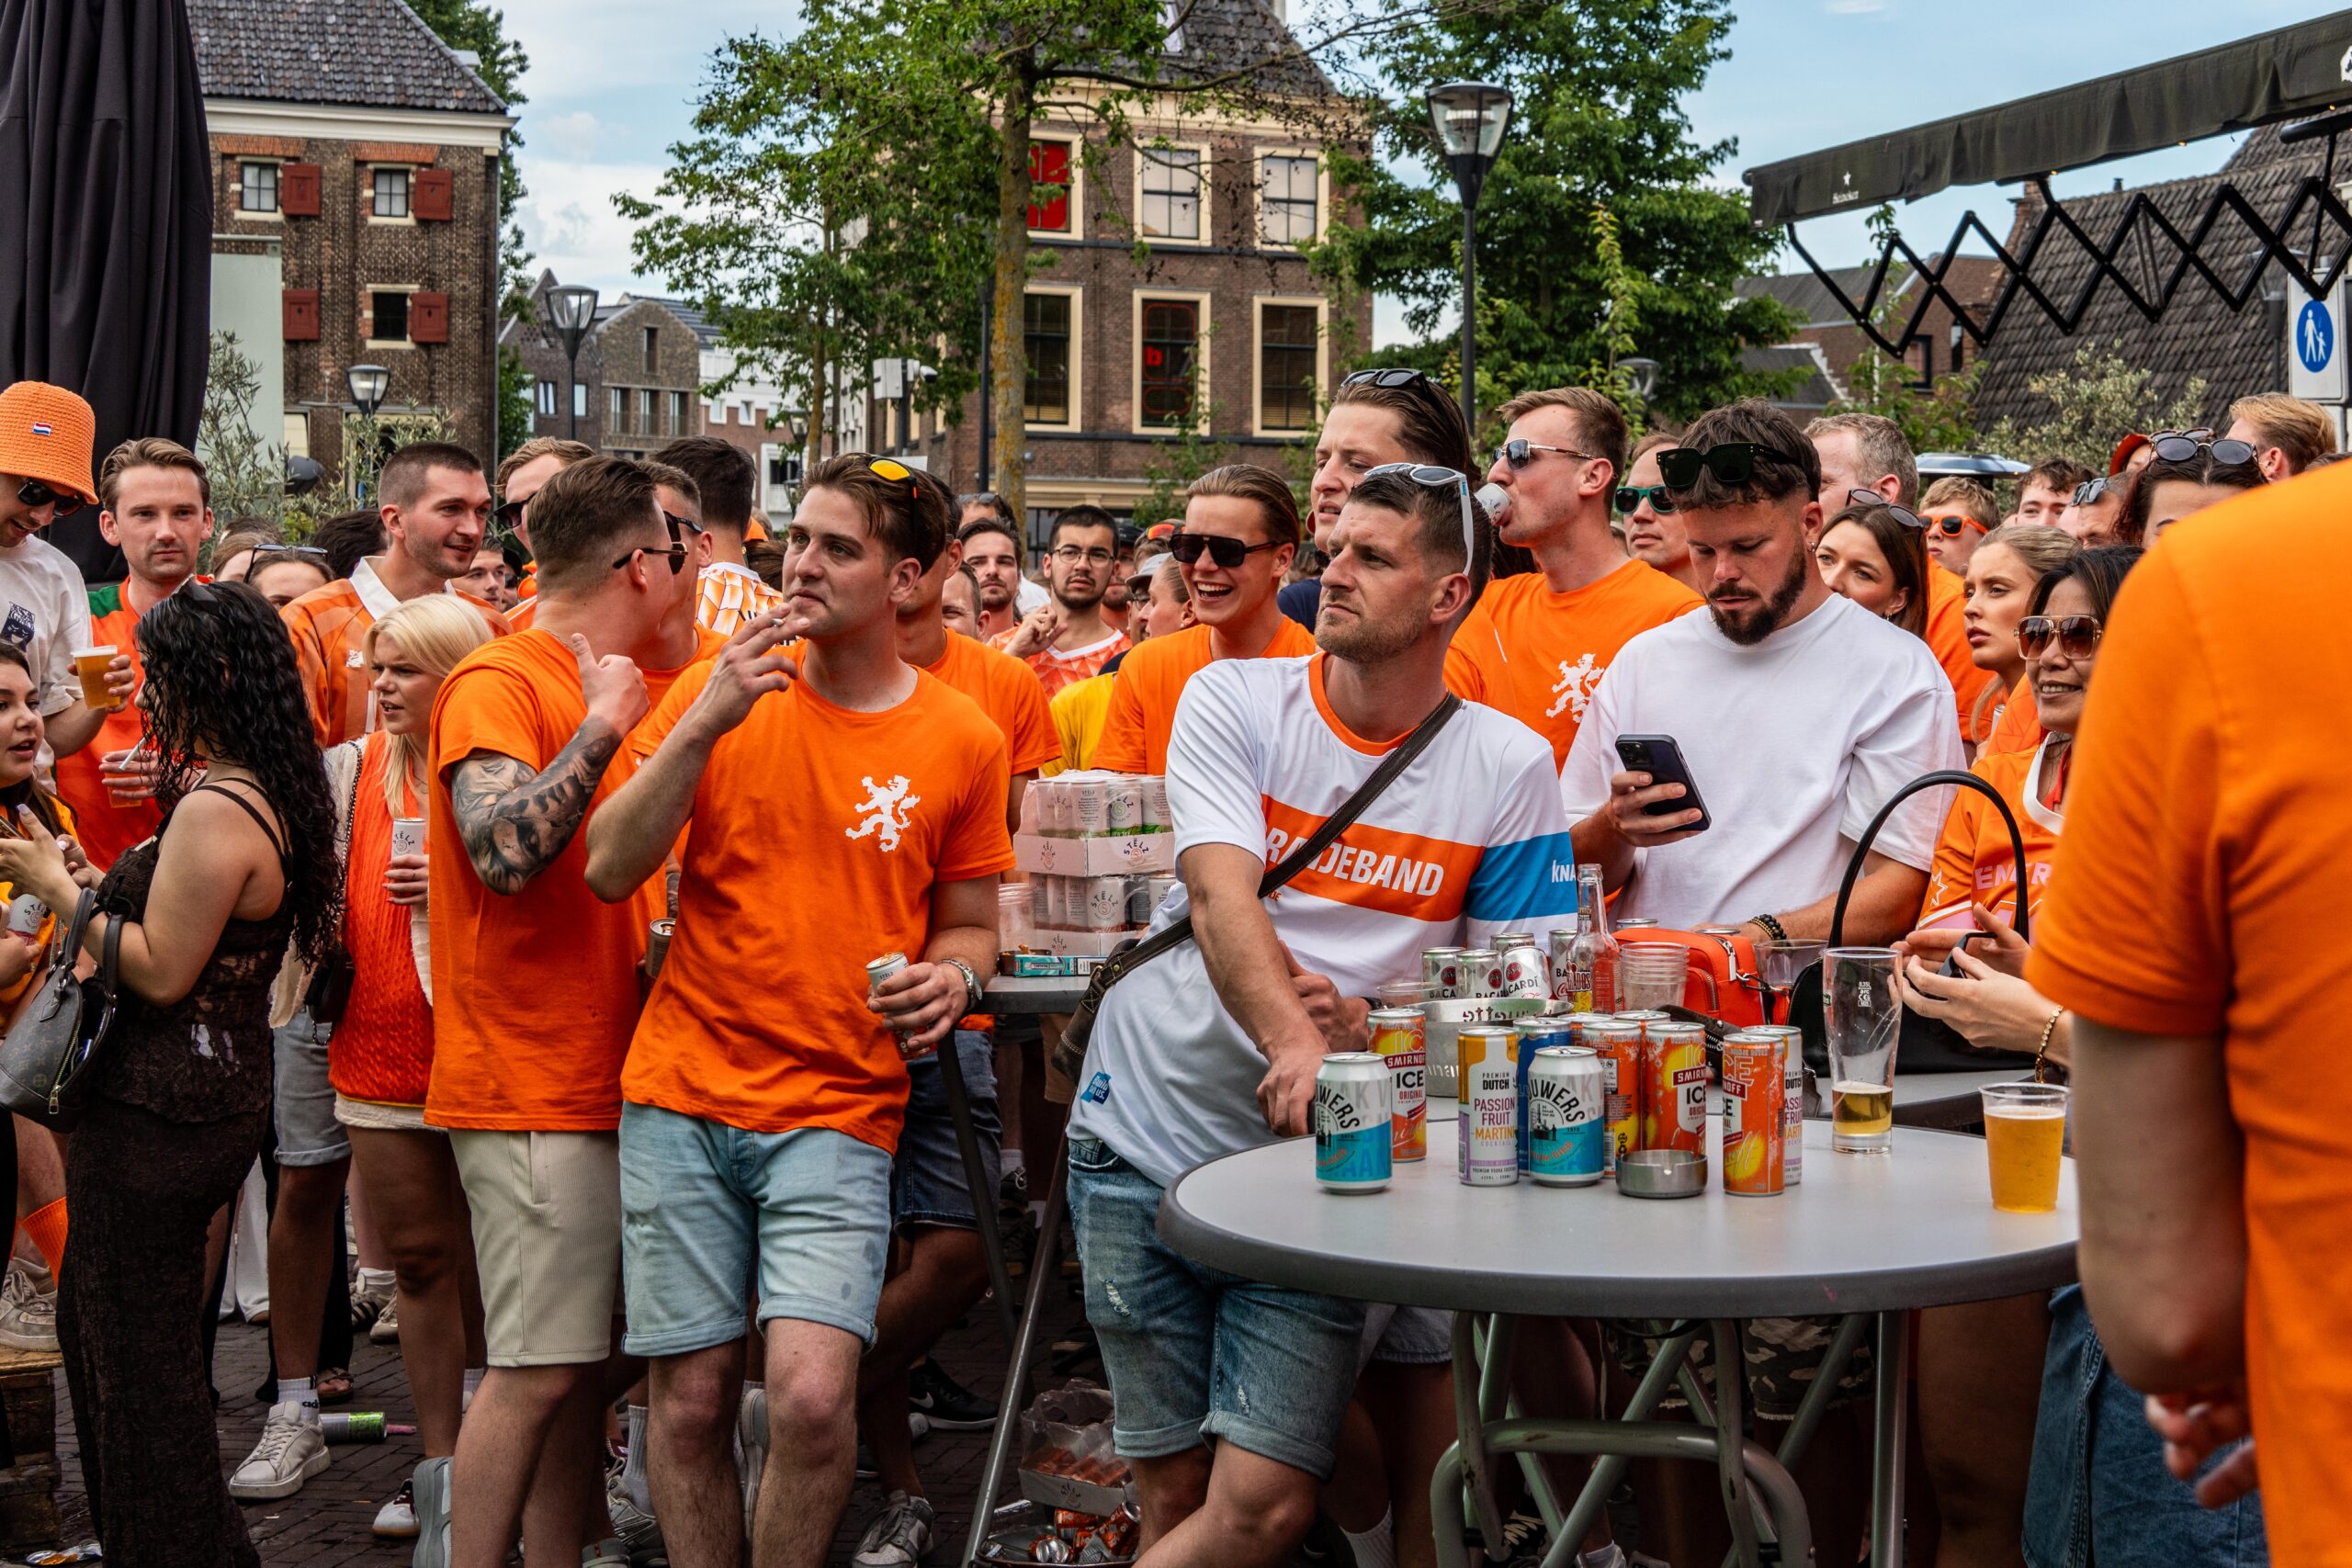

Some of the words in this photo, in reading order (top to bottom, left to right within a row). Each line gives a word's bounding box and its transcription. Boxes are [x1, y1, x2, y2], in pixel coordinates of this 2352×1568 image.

[1387, 1054, 1425, 1067] SMIRNOF
[1396, 1069, 1424, 1089] ICE
[1482, 1078, 1510, 1090] DUTCH
[1474, 1097, 1515, 1111] PASSION
[1481, 1111, 1511, 1126] FRUIT
